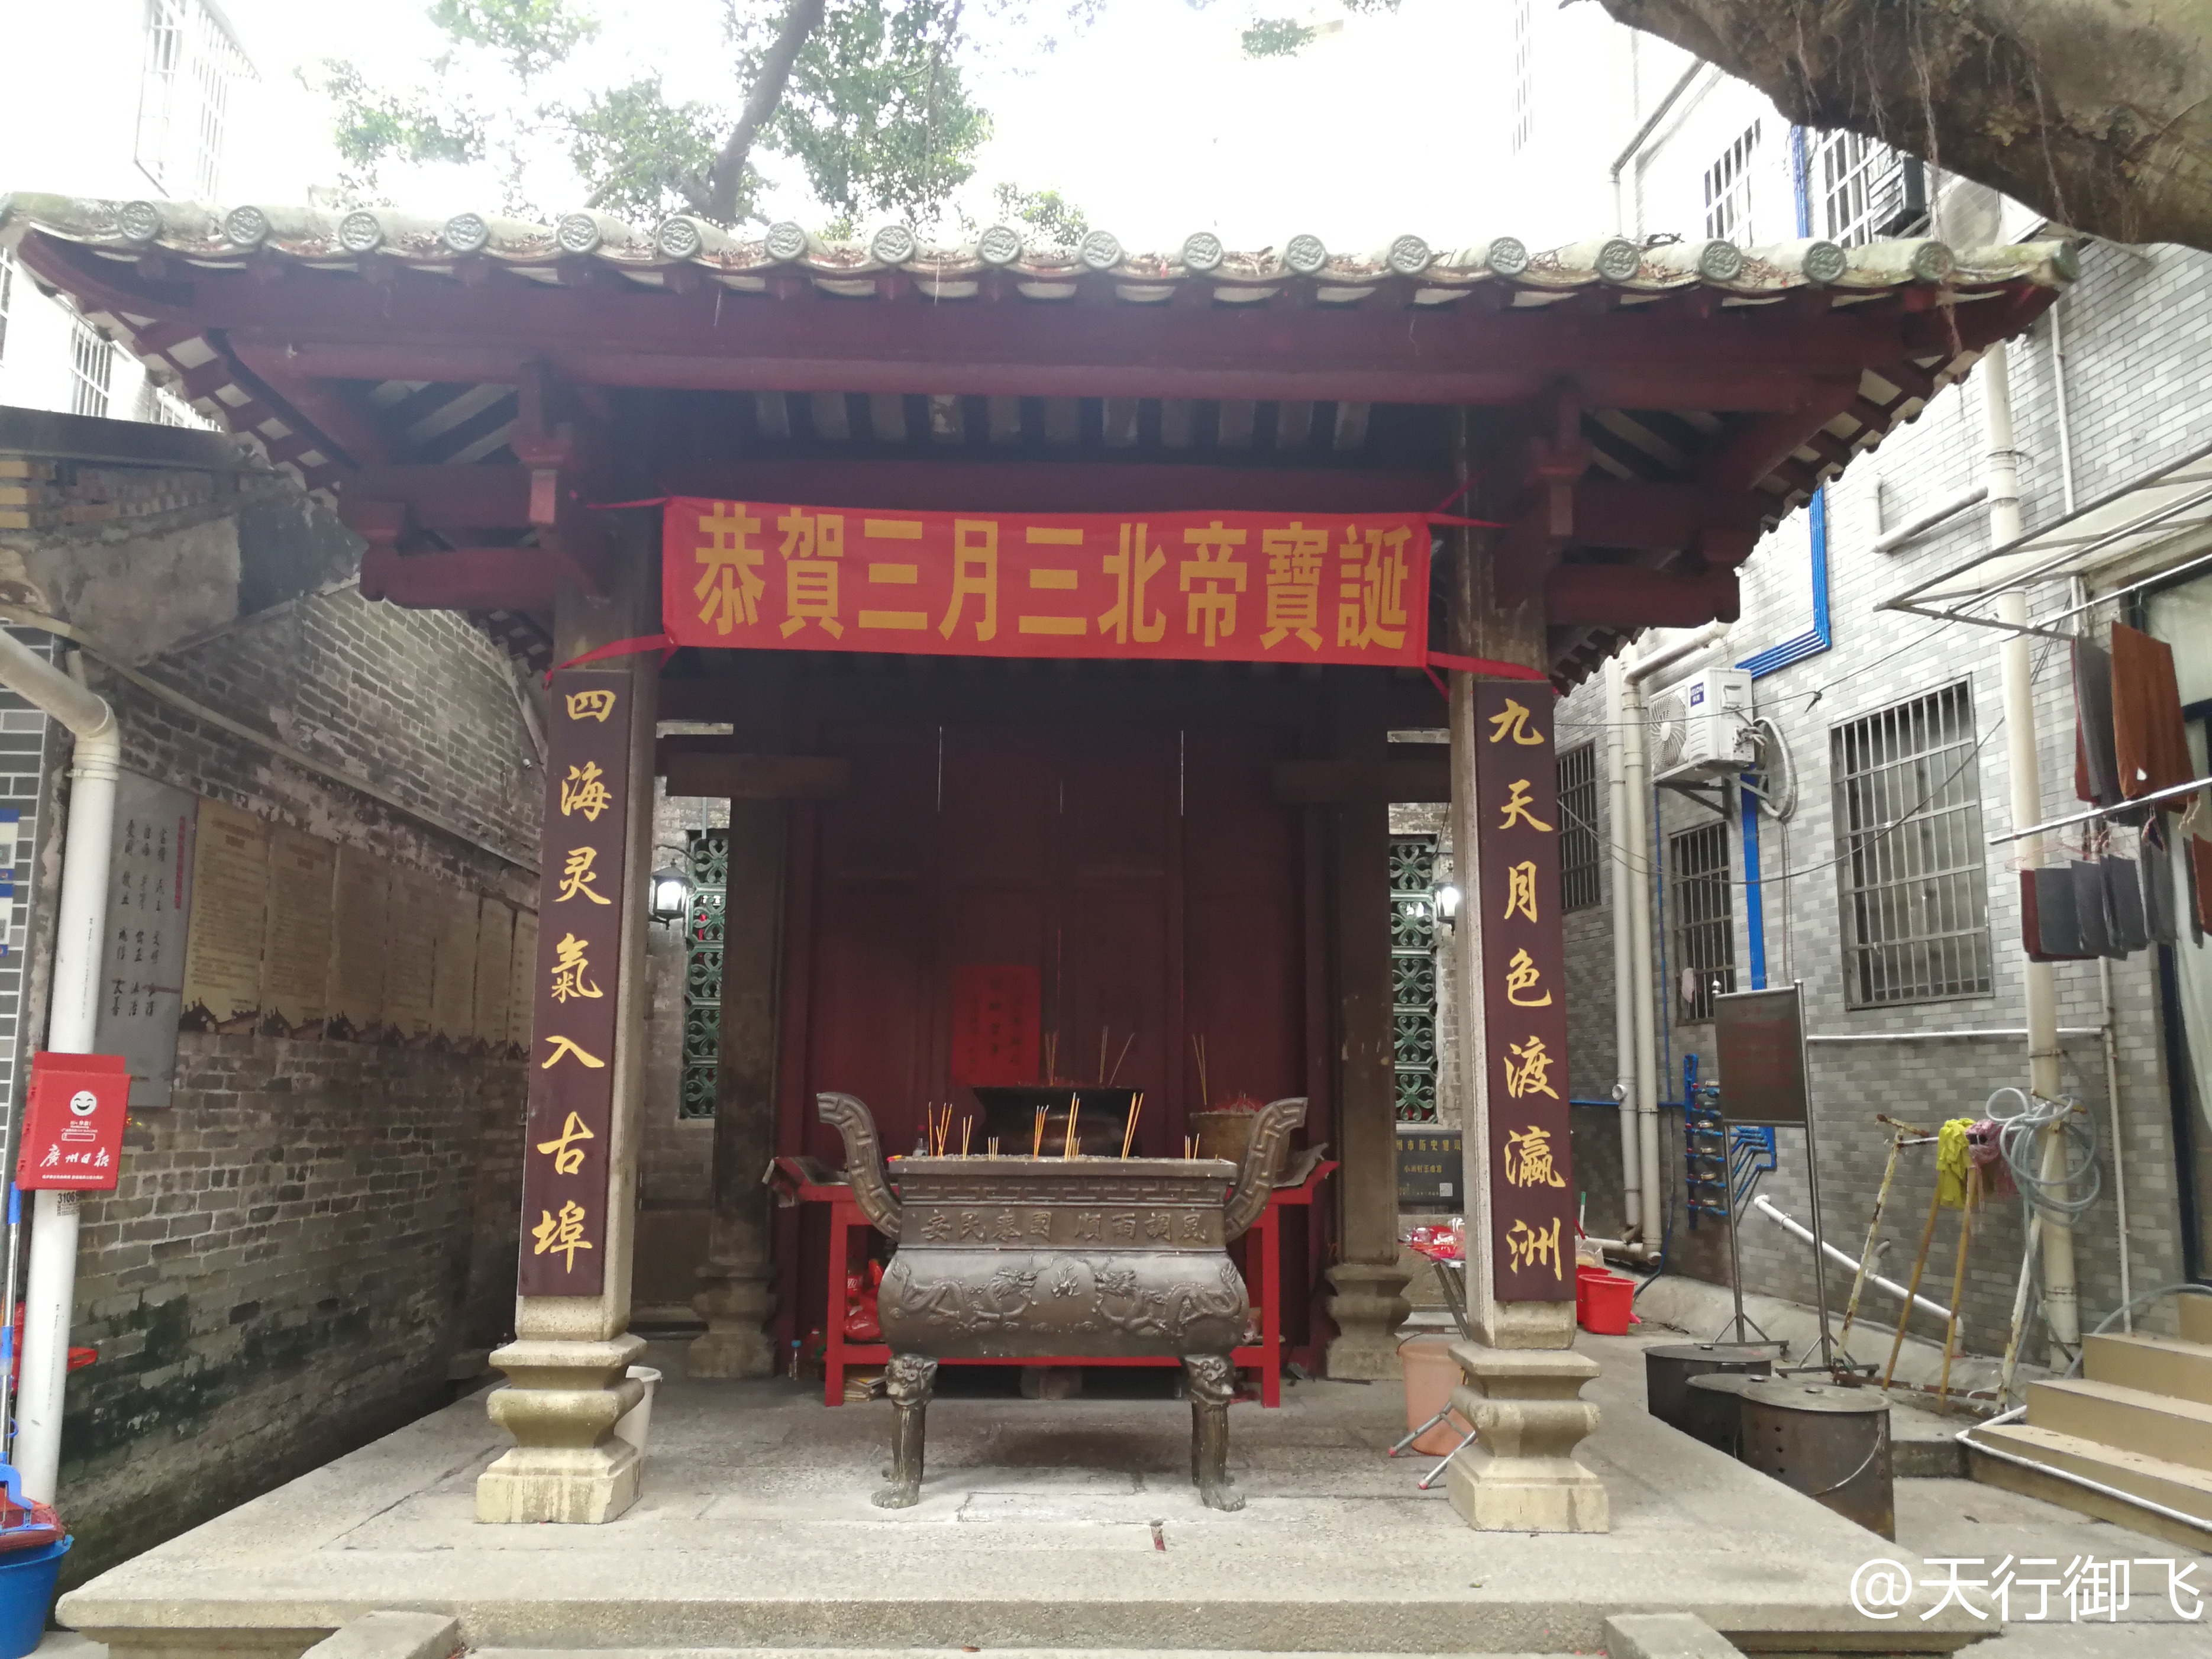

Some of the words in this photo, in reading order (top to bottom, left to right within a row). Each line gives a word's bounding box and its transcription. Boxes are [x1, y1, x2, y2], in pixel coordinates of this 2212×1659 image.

[694, 503, 1412, 651] 恭賀三月三北帝寶誕
[531, 690, 616, 1273] 四海灵氣入古埠
[1488, 698, 1567, 1282] 九天月色渡瀛洲
